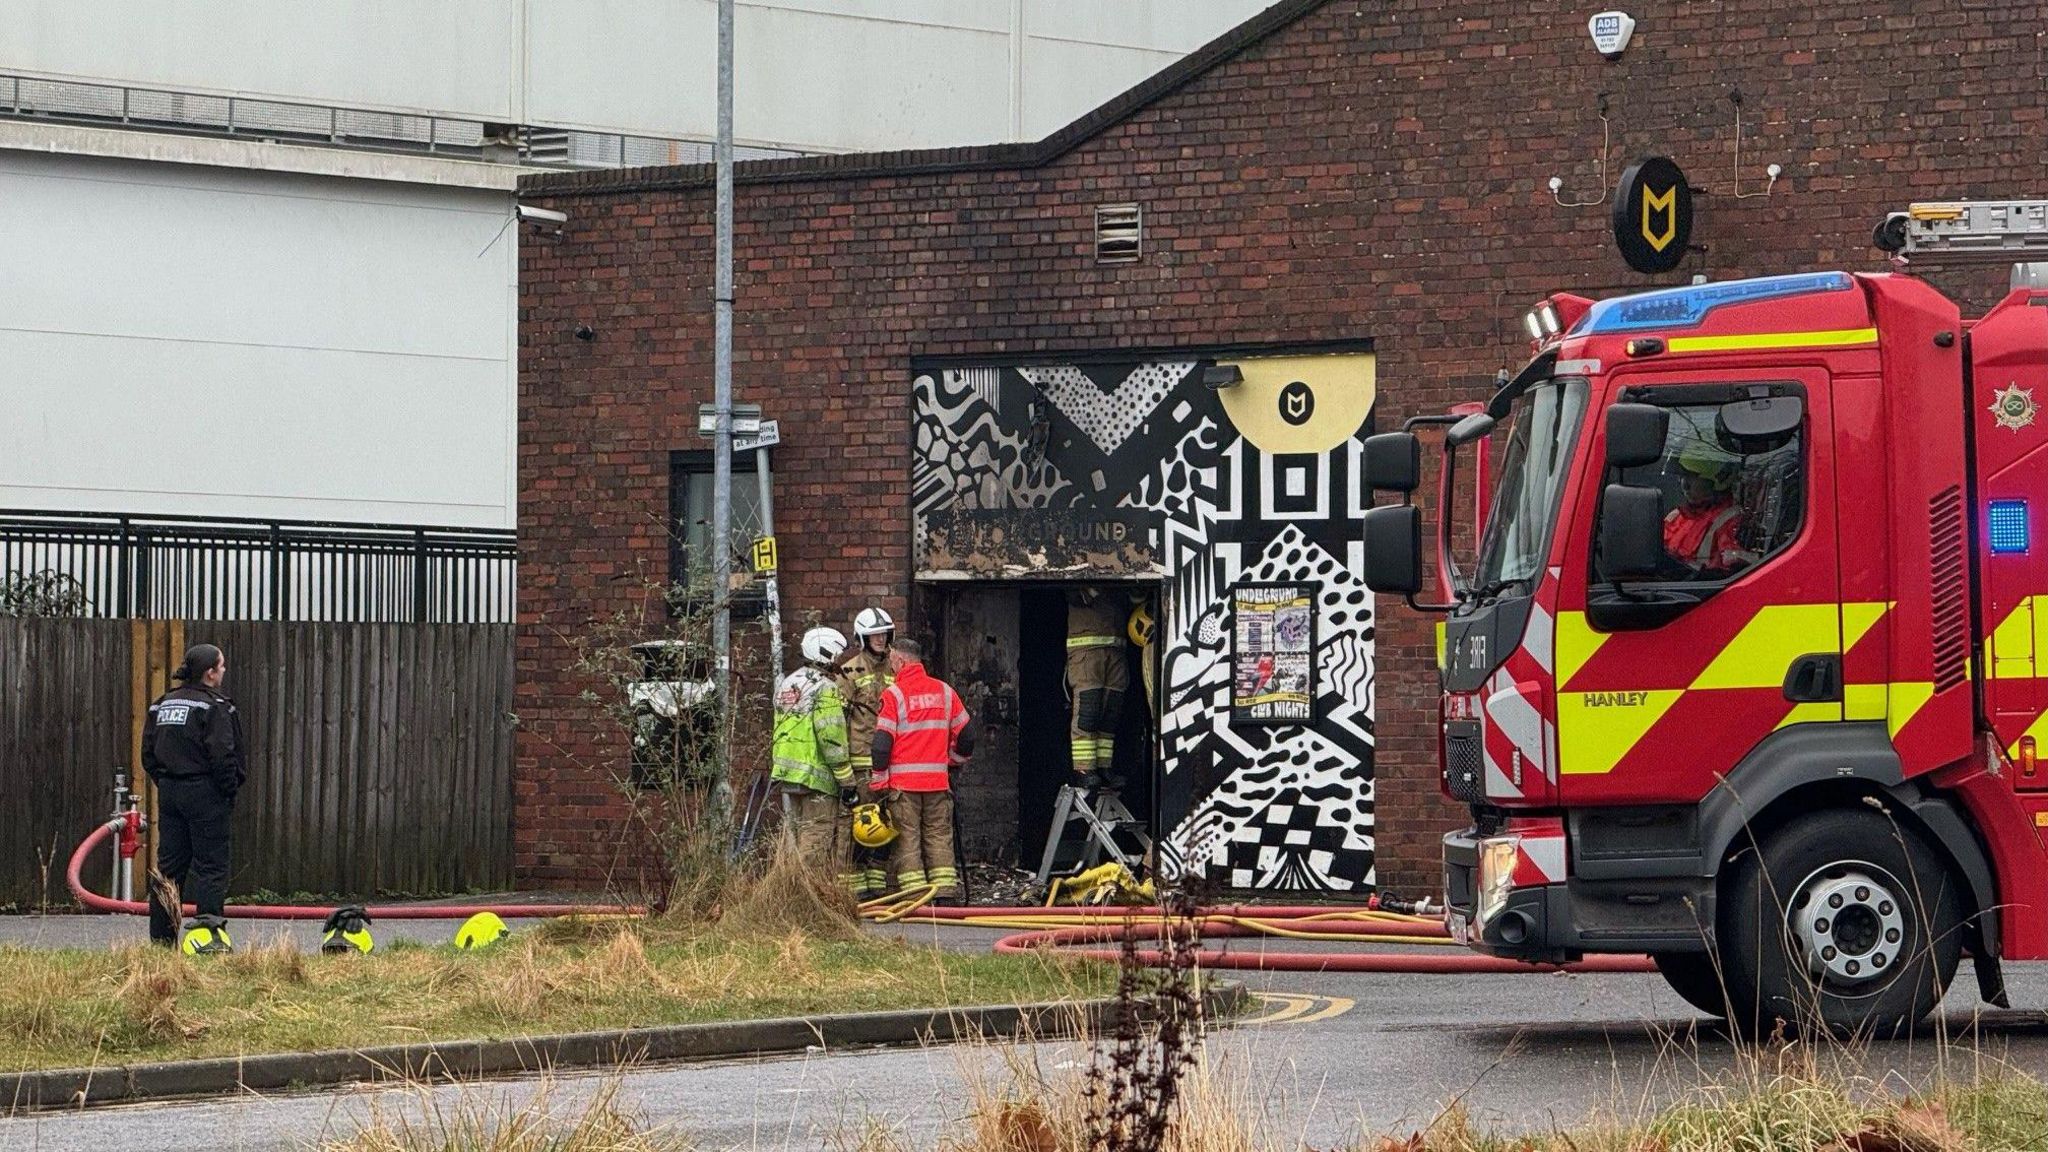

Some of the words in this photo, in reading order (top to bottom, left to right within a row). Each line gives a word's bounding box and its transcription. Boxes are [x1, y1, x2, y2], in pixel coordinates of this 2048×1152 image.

[1597, 18, 1618, 28] ADB
[760, 425, 775, 433] ding
[760, 434, 777, 442] time
[1583, 692, 1648, 707] HANLEY
[157, 708, 186, 722] POLICE
[1250, 702, 1272, 718] CLUB
